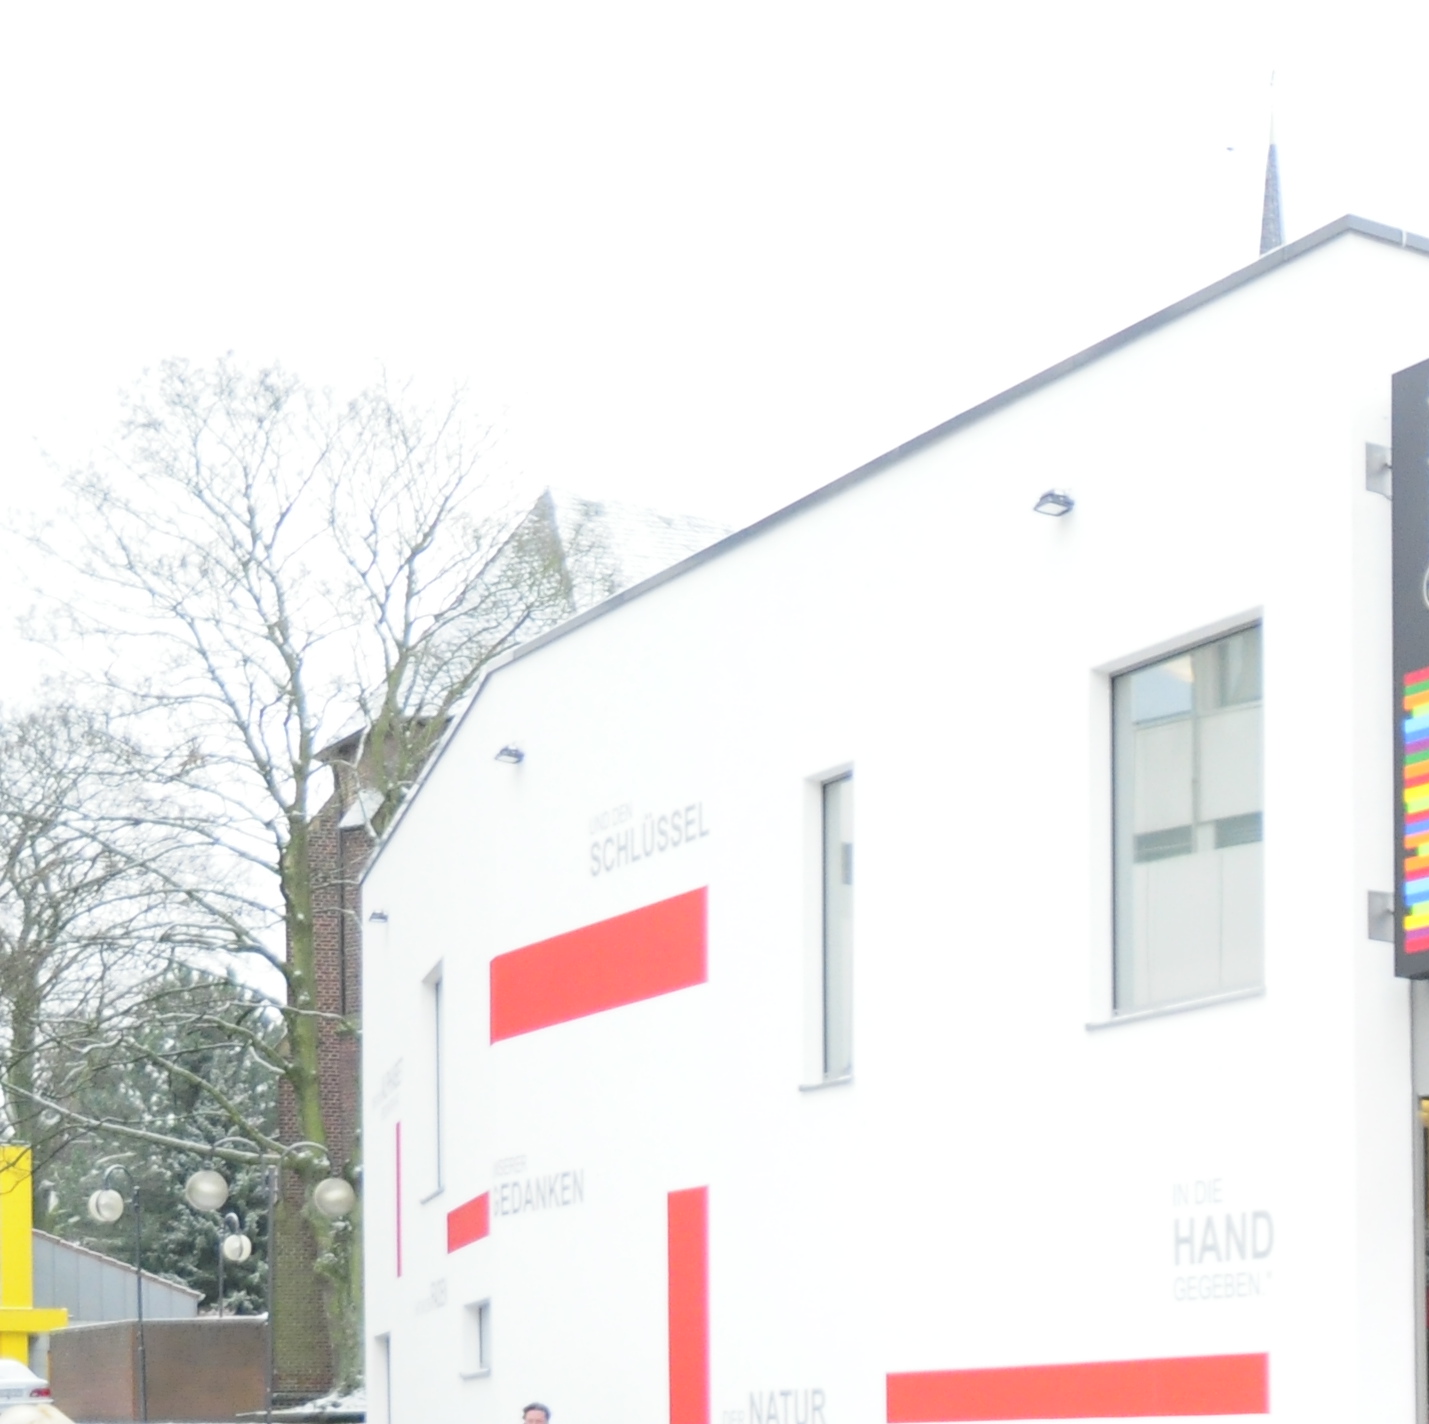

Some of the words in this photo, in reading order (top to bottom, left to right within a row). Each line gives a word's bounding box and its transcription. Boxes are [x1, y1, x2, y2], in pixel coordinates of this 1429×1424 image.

[589, 800, 710, 878] SCHLÜSSEL
[1172, 1183, 1189, 1207] IN
[1194, 1177, 1223, 1205] DIE
[1173, 1209, 1275, 1267] HAND
